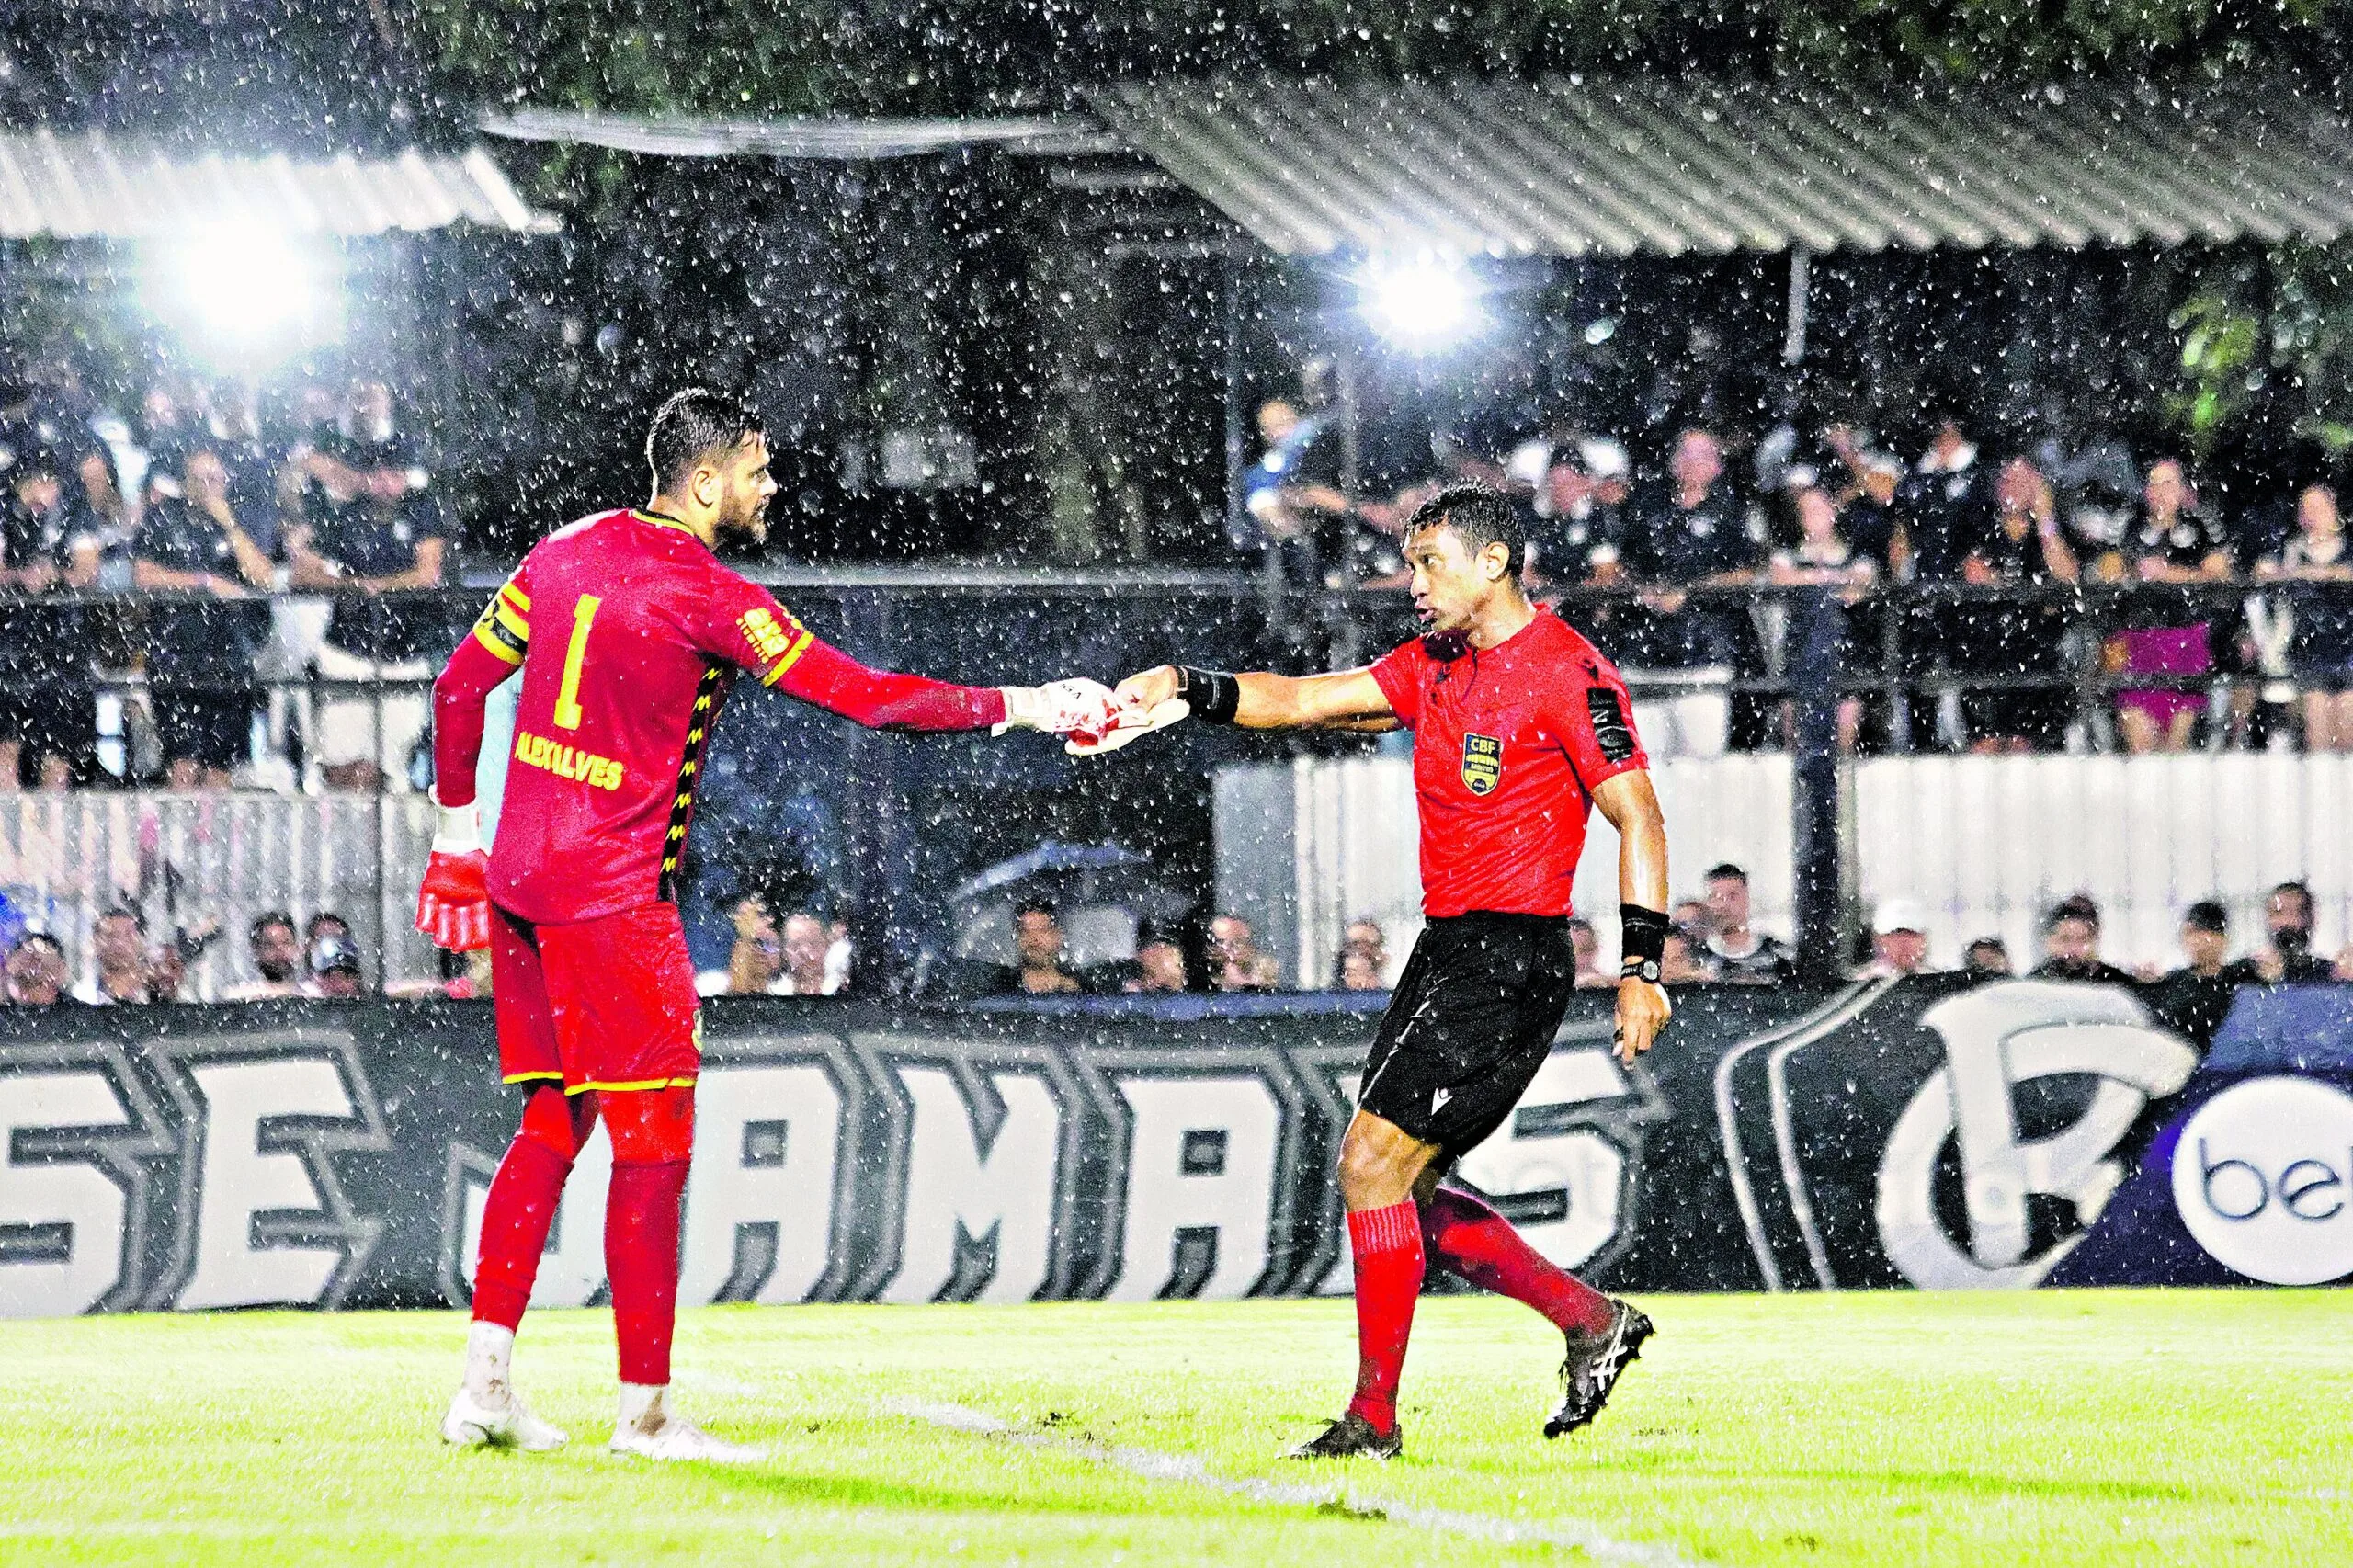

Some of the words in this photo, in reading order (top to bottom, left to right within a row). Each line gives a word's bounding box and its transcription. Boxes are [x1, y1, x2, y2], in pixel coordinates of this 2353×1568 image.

[553, 593, 602, 731] 1
[1471, 738, 1496, 754] CBF
[455, 1046, 1641, 1307] AMAS
[2198, 1136, 2353, 1223] be
